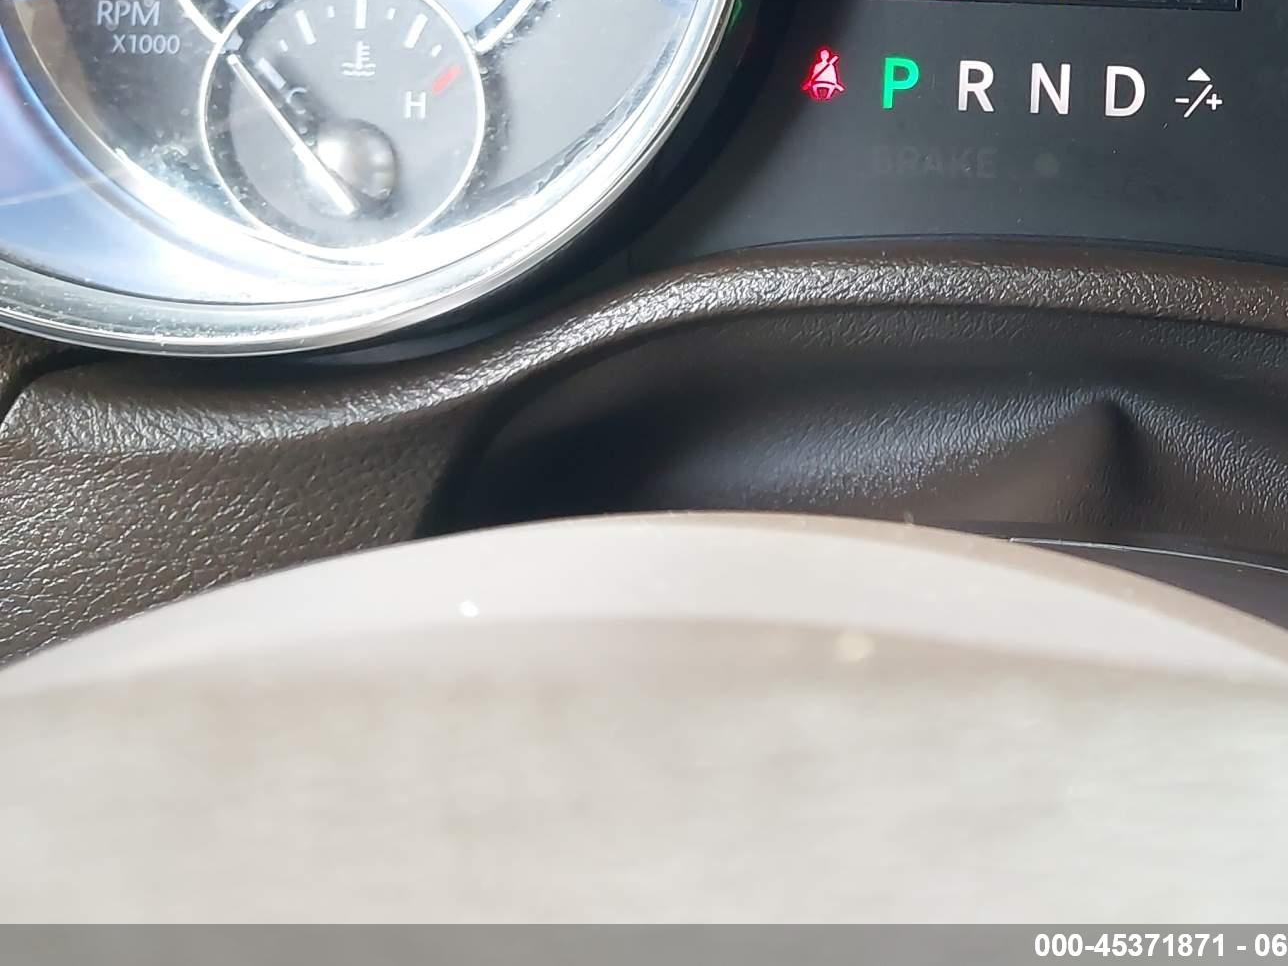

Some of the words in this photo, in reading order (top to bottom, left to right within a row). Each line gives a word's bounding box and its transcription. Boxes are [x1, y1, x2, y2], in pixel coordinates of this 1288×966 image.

[97, 0, 160, 27] RPM
[112, 33, 181, 55] X1000
[882, 57, 921, 109] P
[957, 60, 994, 113] R
[1030, 62, 1071, 115] N
[1105, 65, 1146, 118] D
[404, 91, 427, 119] H
